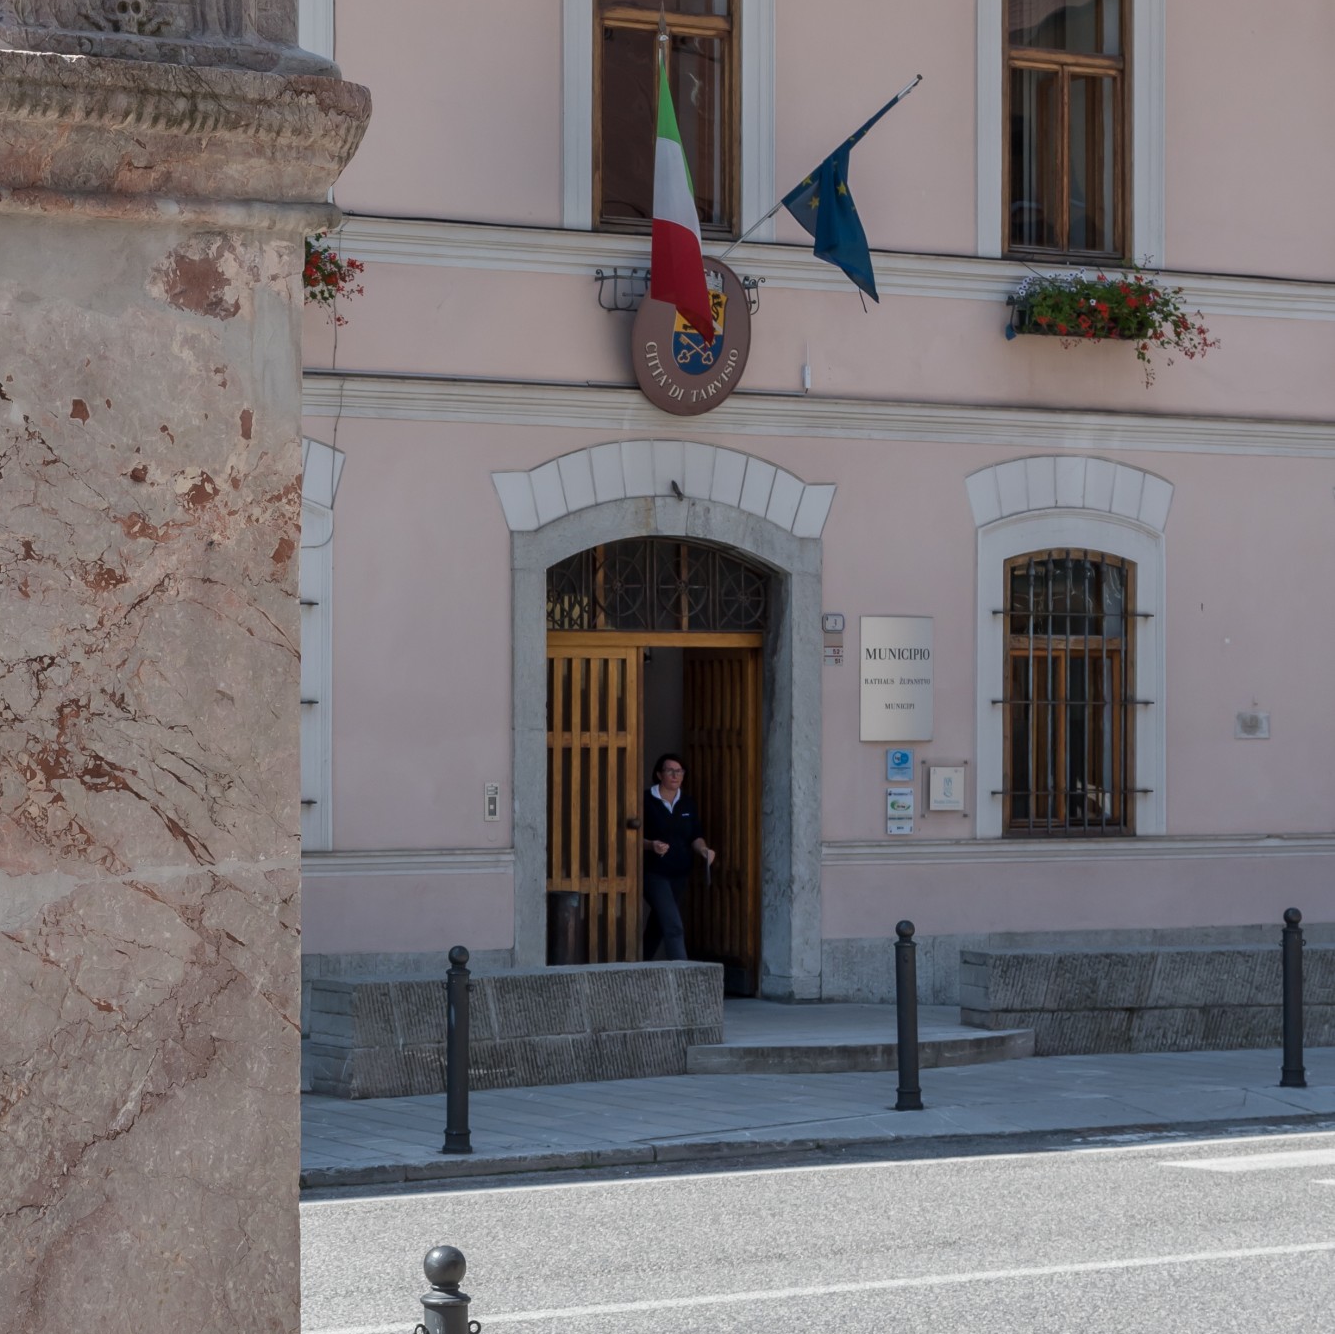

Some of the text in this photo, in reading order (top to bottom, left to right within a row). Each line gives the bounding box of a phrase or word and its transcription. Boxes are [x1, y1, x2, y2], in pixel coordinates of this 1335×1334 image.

[668, 384, 684, 401] DI
[690, 348, 739, 403] TARVISIO
[865, 647, 931, 660] MUNICIPIO
[884, 702, 915, 710] MUNICIPI
